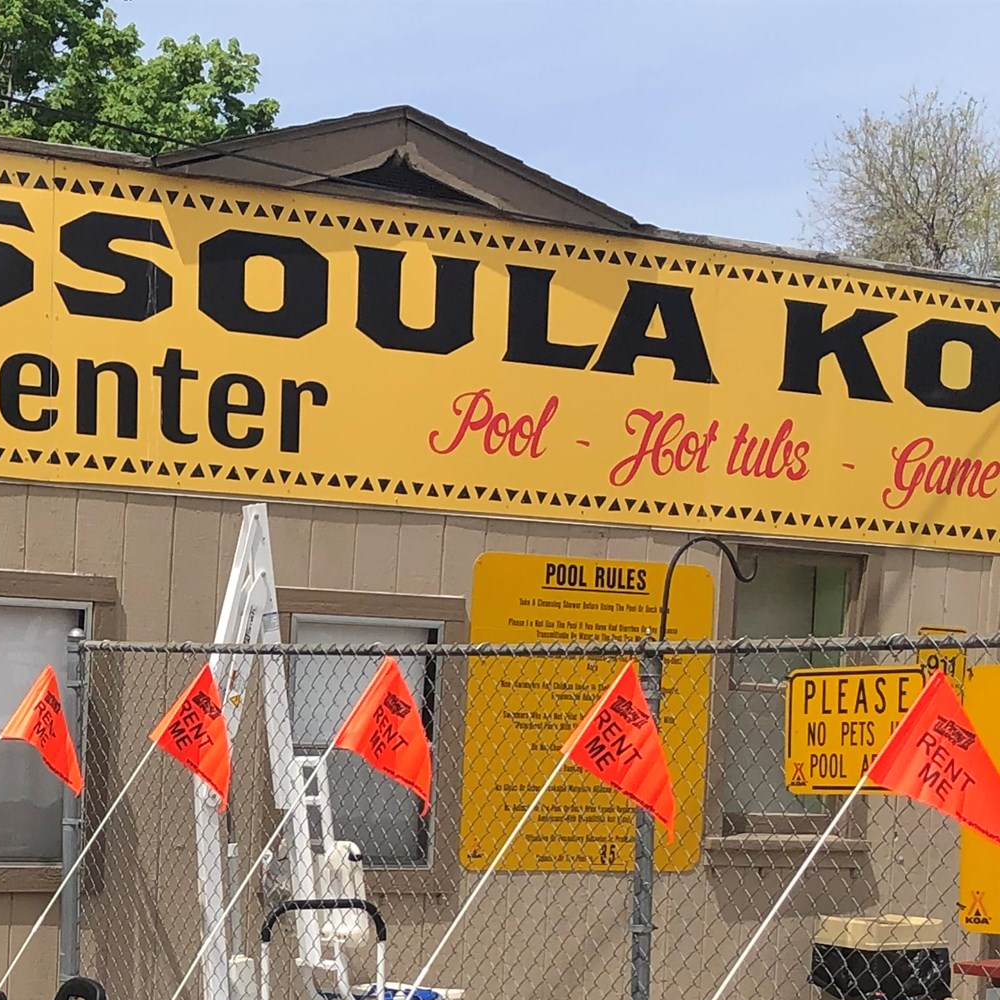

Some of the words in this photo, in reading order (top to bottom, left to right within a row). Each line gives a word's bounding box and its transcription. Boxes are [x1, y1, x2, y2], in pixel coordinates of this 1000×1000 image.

[428, 388, 559, 460] Pool
[609, 408, 719, 487] Hot
[726, 418, 810, 481] tubs
[545, 563, 587, 587] POOL
[595, 566, 647, 590] RULES
[804, 677, 910, 715] PLEASE
[168, 720, 193, 751] ME
[180, 701, 214, 749] RENT
[373, 705, 409, 751] RENT
[596, 709, 642, 765] RENT
[808, 722, 826, 746] NO
[841, 721, 875, 746] PETS
[369, 730, 386, 760] ME
[584, 736, 616, 771] ME
[916, 731, 976, 791] RENT
[810, 754, 847, 778] POOL
[918, 763, 953, 802] ME
[965, 917, 990, 925] KOA
